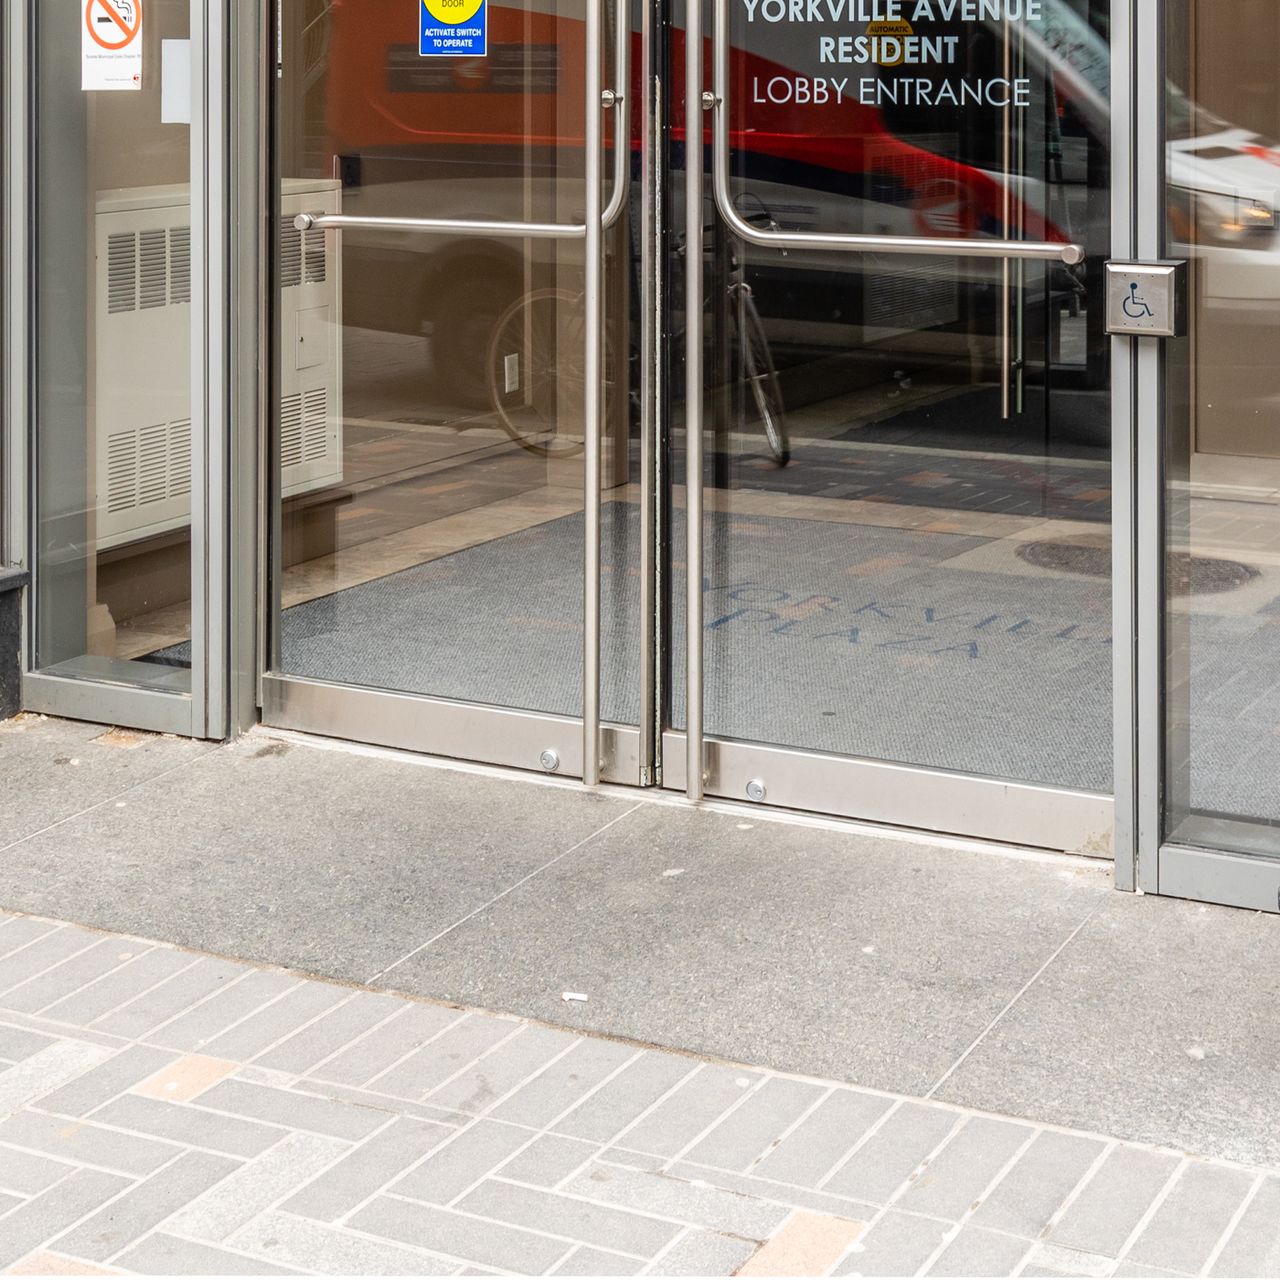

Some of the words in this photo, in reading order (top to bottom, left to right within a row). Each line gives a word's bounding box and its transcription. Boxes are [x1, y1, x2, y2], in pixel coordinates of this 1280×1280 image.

[442, 0, 464, 8] DOOR
[424, 28, 455, 37] ACTIVATE
[456, 28, 482, 37] SWITCH
[433, 39, 442, 48] TO
[443, 39, 473, 48] OPERATE
[819, 36, 959, 64] RESIDENT
[752, 76, 848, 105] LOBBY
[859, 78, 1031, 106] ENTRANCE
